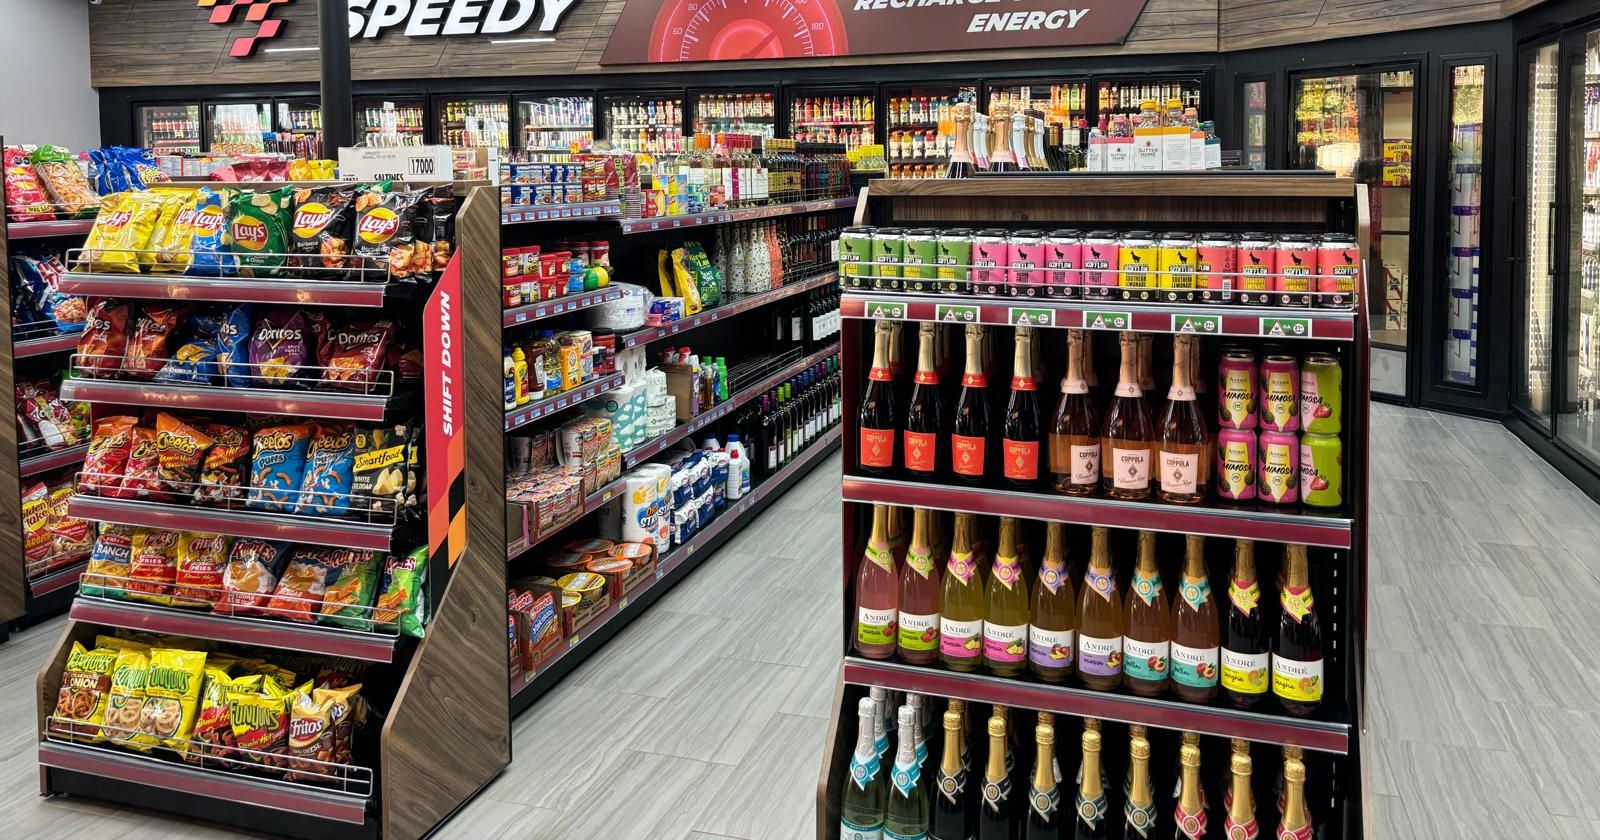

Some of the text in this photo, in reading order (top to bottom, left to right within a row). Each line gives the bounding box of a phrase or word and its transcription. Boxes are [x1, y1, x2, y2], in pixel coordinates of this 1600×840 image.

[687, 3, 698, 11] 80
[854, 0, 990, 10] RECHAR
[967, 9, 1089, 32] ENERGY
[811, 23, 824, 31] 180
[411, 158, 434, 174] 17000
[194, 212, 223, 230] Lay's
[361, 215, 398, 234] Lay's
[234, 225, 265, 241] Lay's
[258, 328, 301, 340] Doritos
[339, 333, 380, 345] Doritos
[440, 291, 453, 437] SHIFT DOWN
[1224, 392, 1253, 400] MIMOSA
[1266, 394, 1296, 402] MIMOSA
[1301, 394, 1323, 403] MOSA
[866, 434, 887, 442] COPPOLA
[908, 437, 928, 446] COPPOLA
[157, 431, 196, 456] Cheetos
[956, 441, 976, 450] COPPOLA
[1009, 446, 1031, 454] COPPOLA
[1079, 450, 1098, 458] COPPOLA
[259, 454, 284, 468] PUFFS
[356, 451, 400, 468] Smartfood
[1121, 455, 1144, 463] COPPOLA
[1166, 459, 1190, 467] COPPOLA
[1223, 463, 1253, 471] MIMOSA
[1263, 466, 1293, 474] MIMOSA
[1301, 467, 1319, 476] MOSA
[23, 502, 46, 517] olden
[26, 510, 48, 526] lake
[97, 544, 130, 557] RANCH
[70, 678, 98, 689] ONION
[230, 699, 280, 731] FUNYUNS
[290, 718, 323, 737] Fritos
[261, 733, 272, 743] Hot
